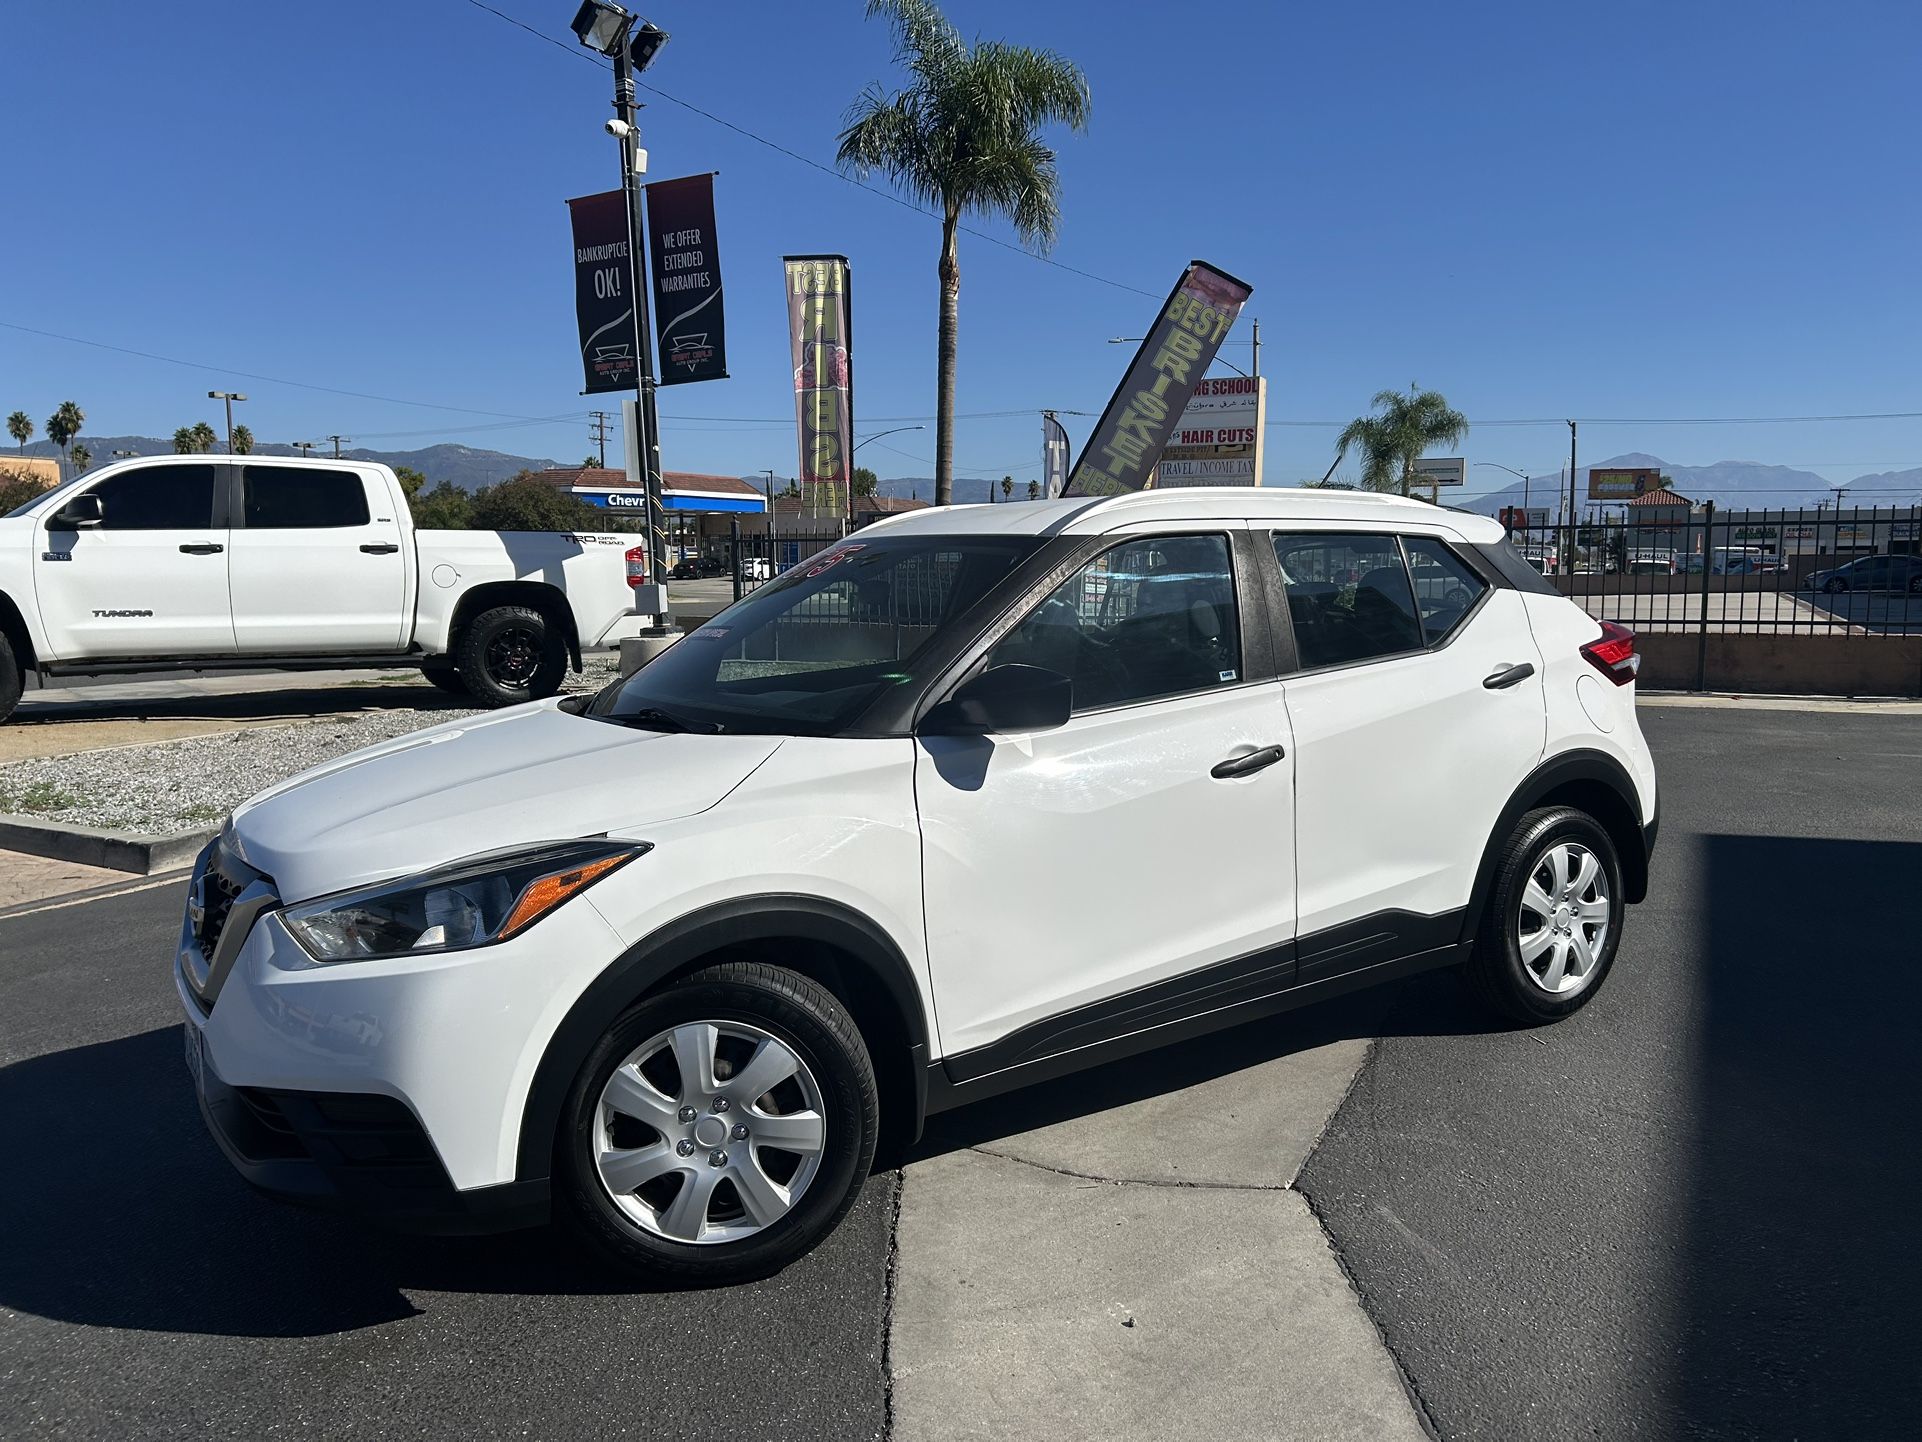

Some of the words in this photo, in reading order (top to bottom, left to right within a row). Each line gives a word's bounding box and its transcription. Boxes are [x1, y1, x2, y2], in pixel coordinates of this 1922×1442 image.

[663, 232, 675, 249] WE
[677, 228, 701, 246] OFFER
[664, 250, 703, 271] EXTENDED
[594, 267, 621, 299] OK!
[661, 271, 710, 293] WARRANTIES
[1166, 291, 1234, 344] BEST
[1212, 379, 1258, 395] SCHOOL
[1104, 325, 1204, 476] BRISKET
[1181, 430, 1213, 444] HAIR
[1217, 428, 1255, 443] CUTS
[1162, 462, 1194, 476] TRAVEL
[1200, 460, 1235, 475] INCOME
[1237, 459, 1254, 473] TAX
[560, 534, 597, 545] TRD
[92, 609, 153, 618] TUNDRA
